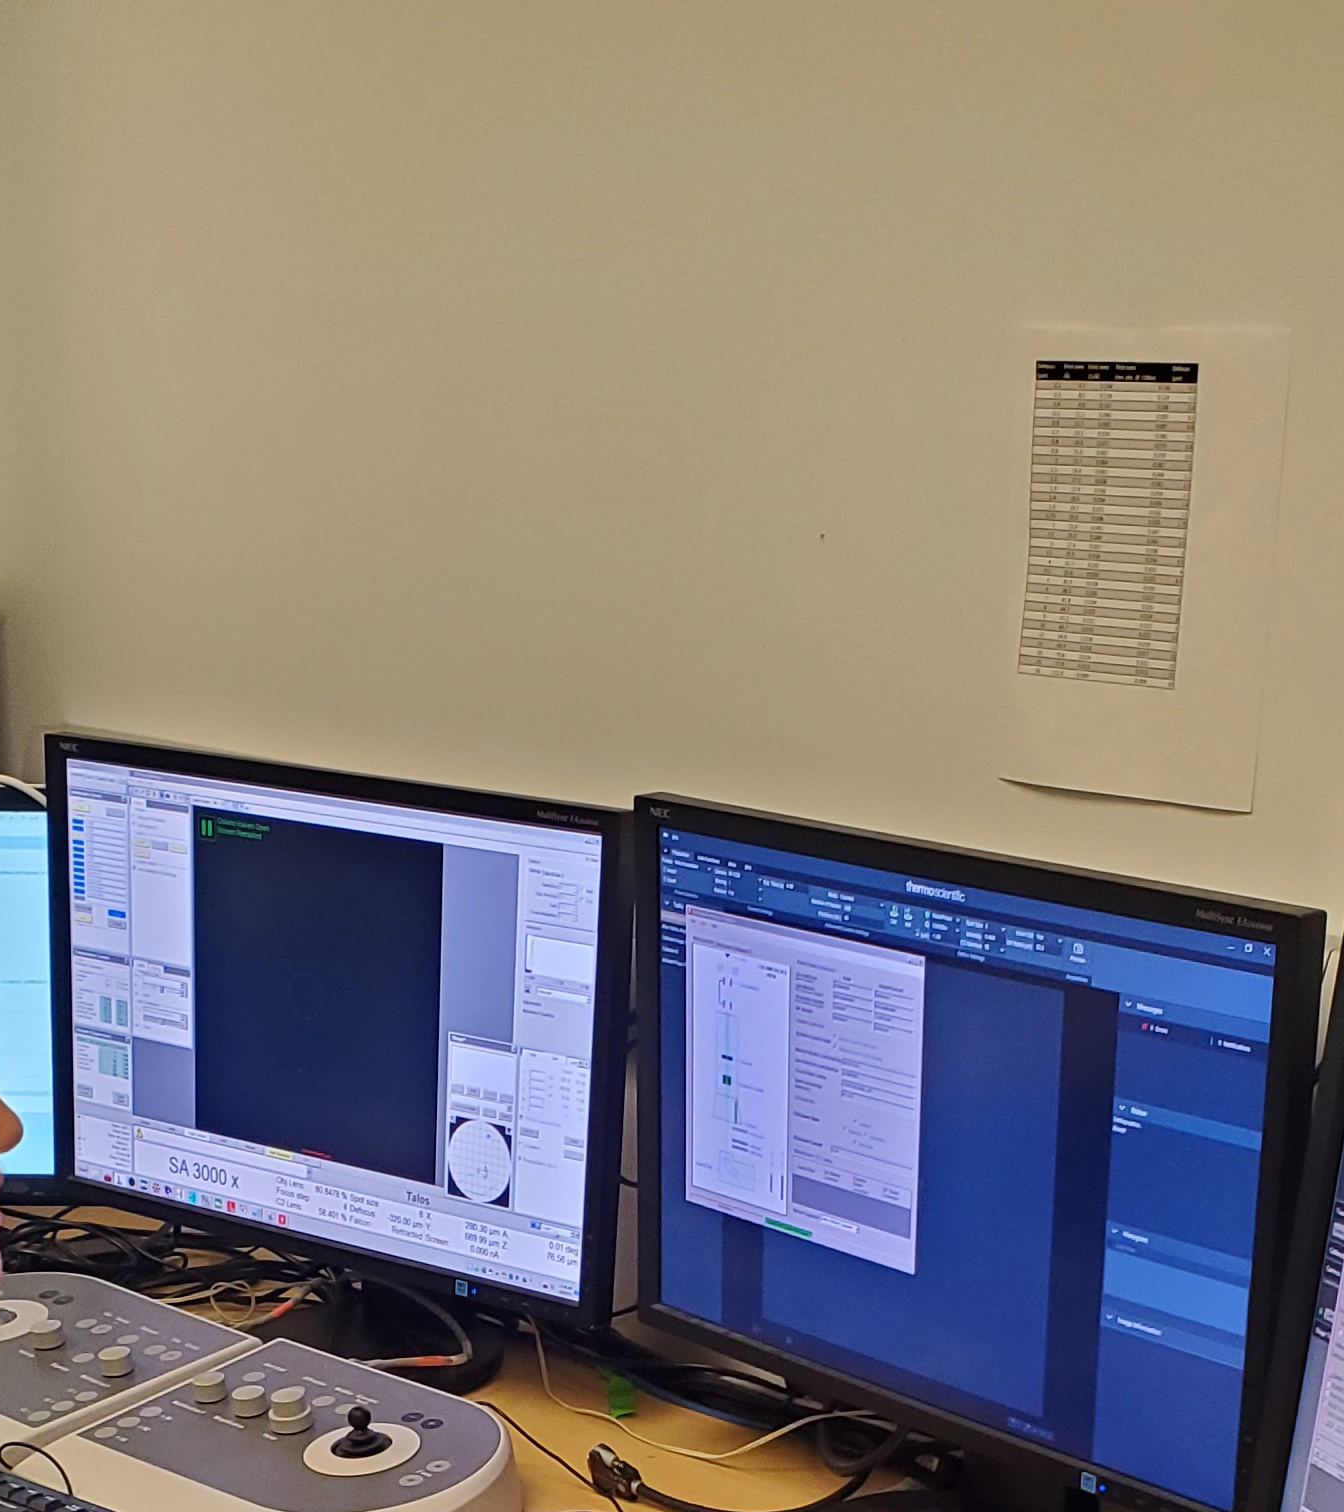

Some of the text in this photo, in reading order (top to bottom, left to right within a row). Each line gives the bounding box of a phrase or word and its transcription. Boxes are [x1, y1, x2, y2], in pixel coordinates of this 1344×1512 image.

[169, 1156, 190, 1177] SA
[193, 1162, 227, 1186] 3000
[276, 1187, 296, 1198] Focus
[406, 1191, 430, 1206] Talos
[276, 1176, 289, 1187] Obj
[350, 1193, 365, 1204] Spot
[549, 1241, 564, 1251] 0.01
[566, 1245, 579, 1257] deg
[276, 1198, 285, 1207] C2
[392, 1226, 423, 1240] Retracted
[470, 1244, 488, 1257] 0.000
[489, 1250, 499, 1259] nA
